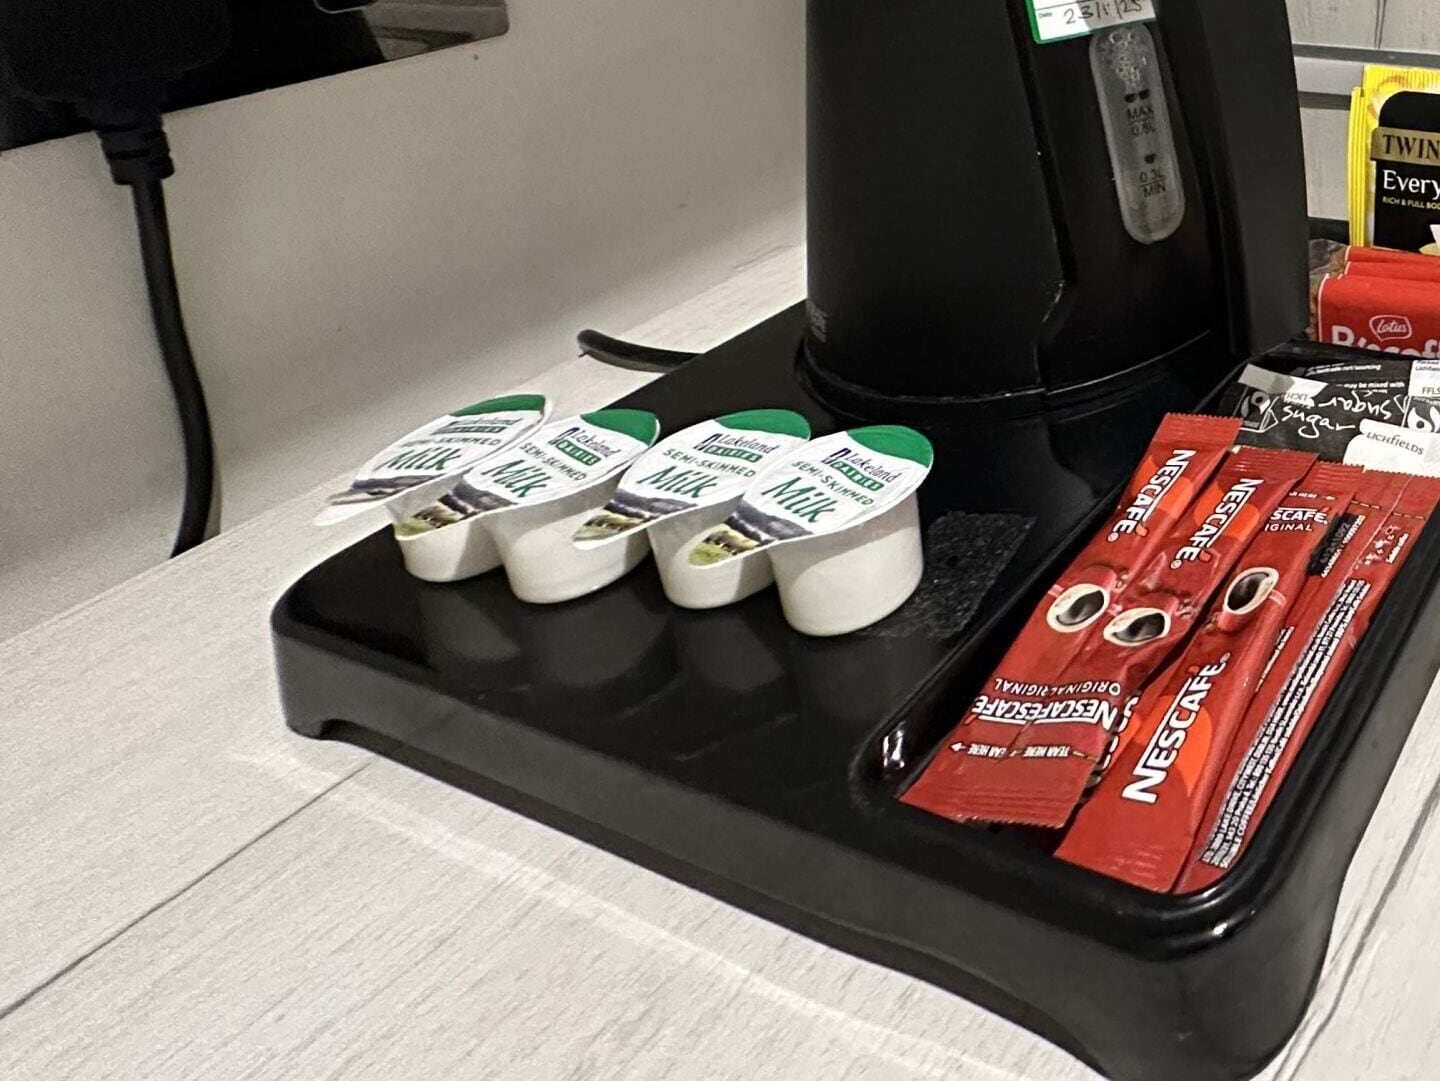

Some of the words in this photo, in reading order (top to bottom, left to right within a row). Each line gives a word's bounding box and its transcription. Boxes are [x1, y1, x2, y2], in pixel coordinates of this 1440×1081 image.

[1377, 319, 1407, 334] Lotus
[1281, 406, 1355, 438] sugar
[481, 459, 552, 498] Milk
[636, 465, 718, 499] Milk
[792, 460, 875, 506] SEMI-SKIMMED
[761, 477, 836, 523] Milk
[1264, 523, 1313, 532] IGINAL
